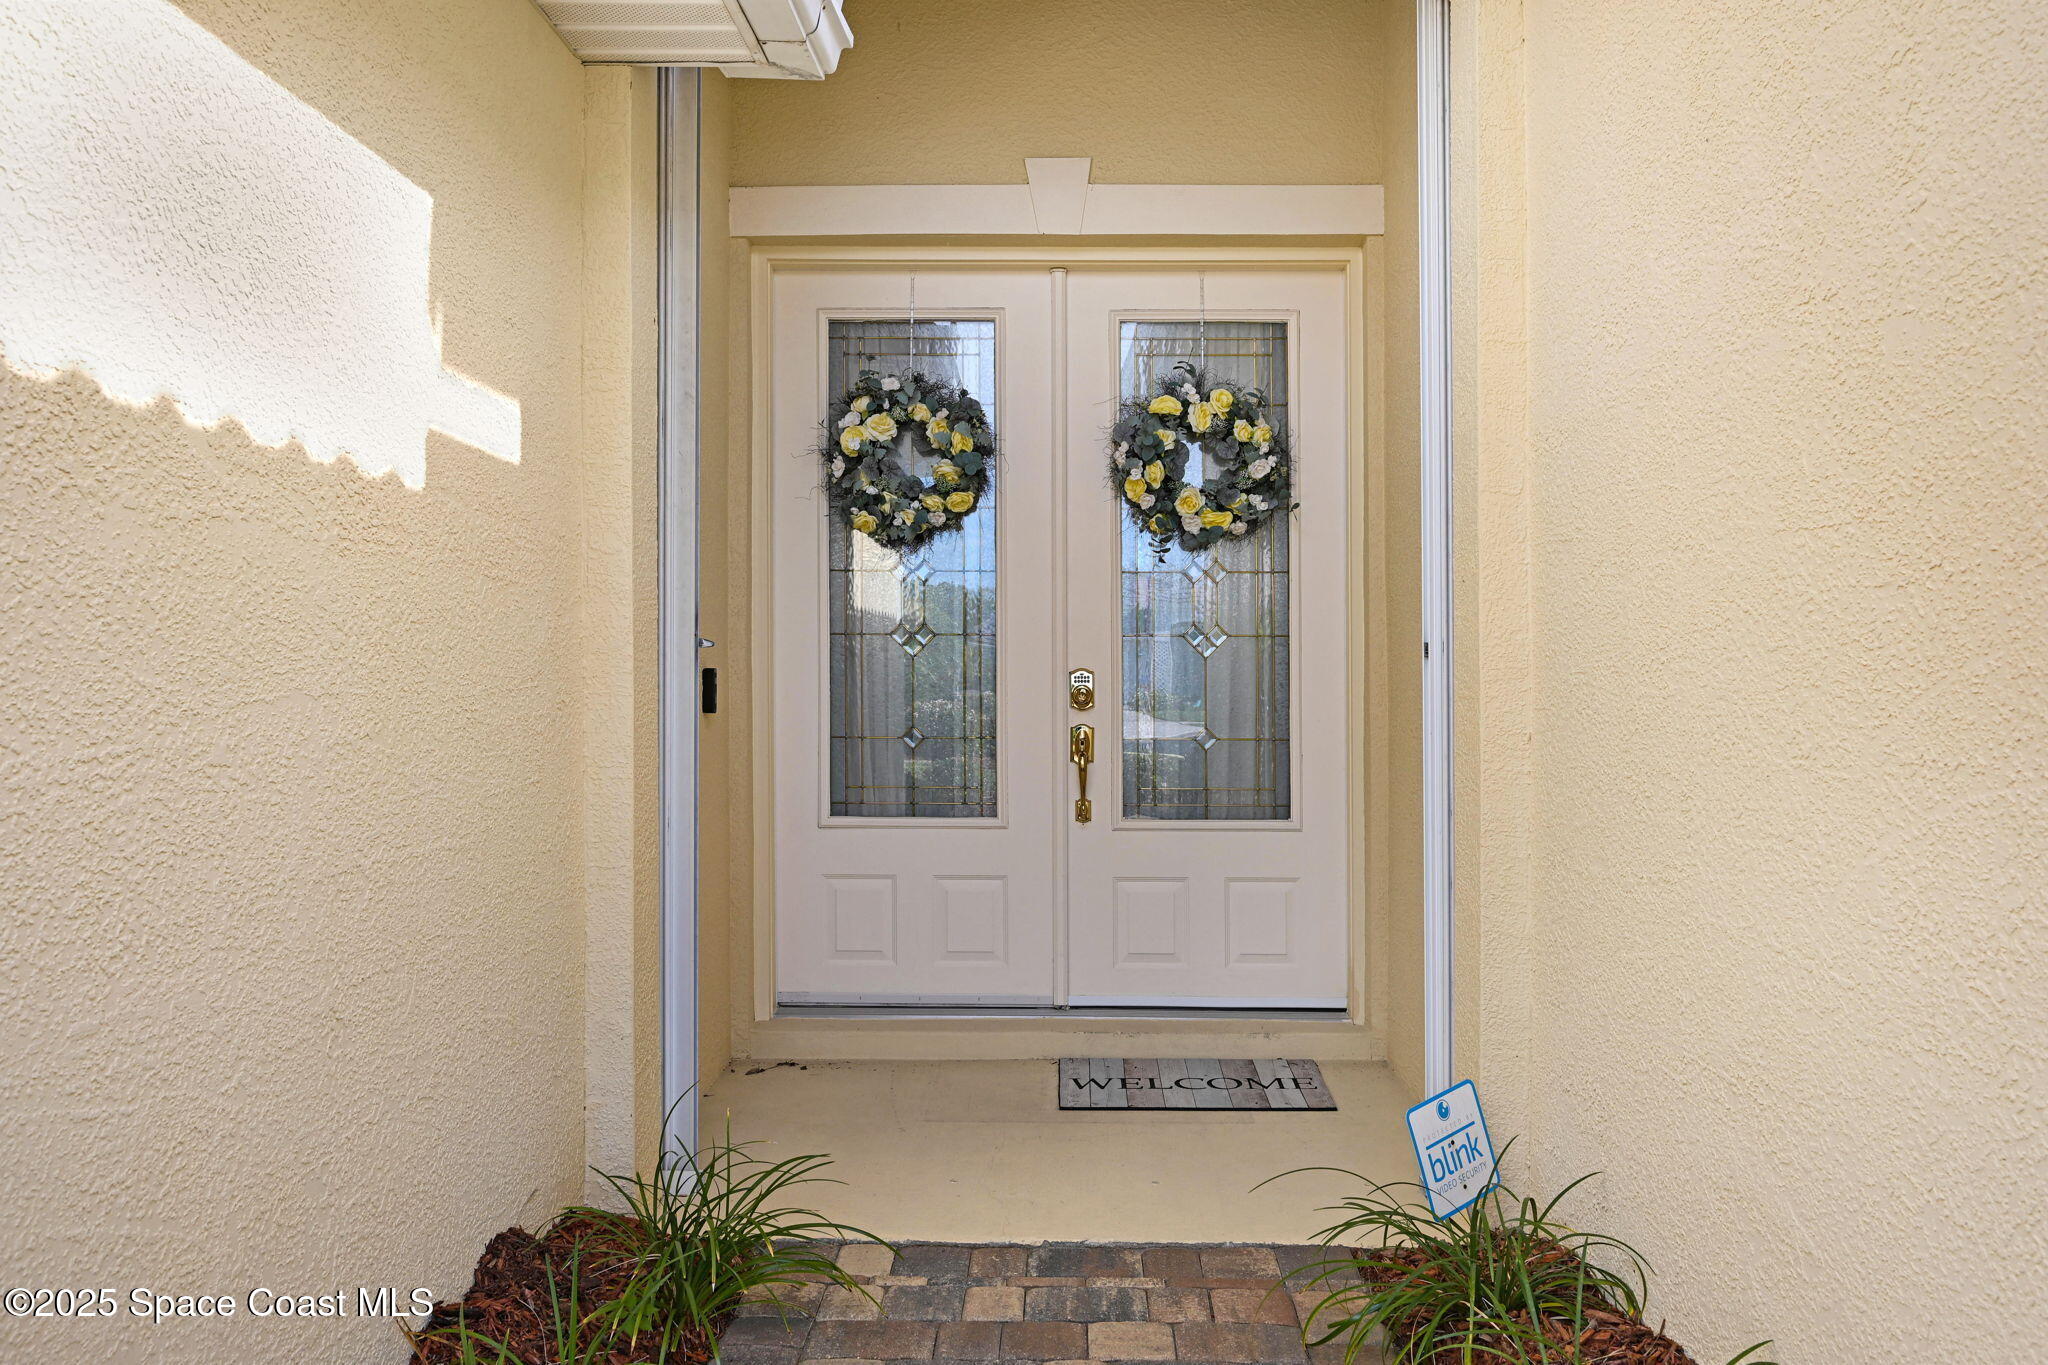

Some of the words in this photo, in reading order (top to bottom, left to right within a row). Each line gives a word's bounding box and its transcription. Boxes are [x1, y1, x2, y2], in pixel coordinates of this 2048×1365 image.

[1068, 1077, 1318, 1091] WELCOME
[1427, 1131, 1484, 1183] blink
[1436, 1178, 1458, 1196] VIDEO
[1459, 1161, 1488, 1184] SECURITY
